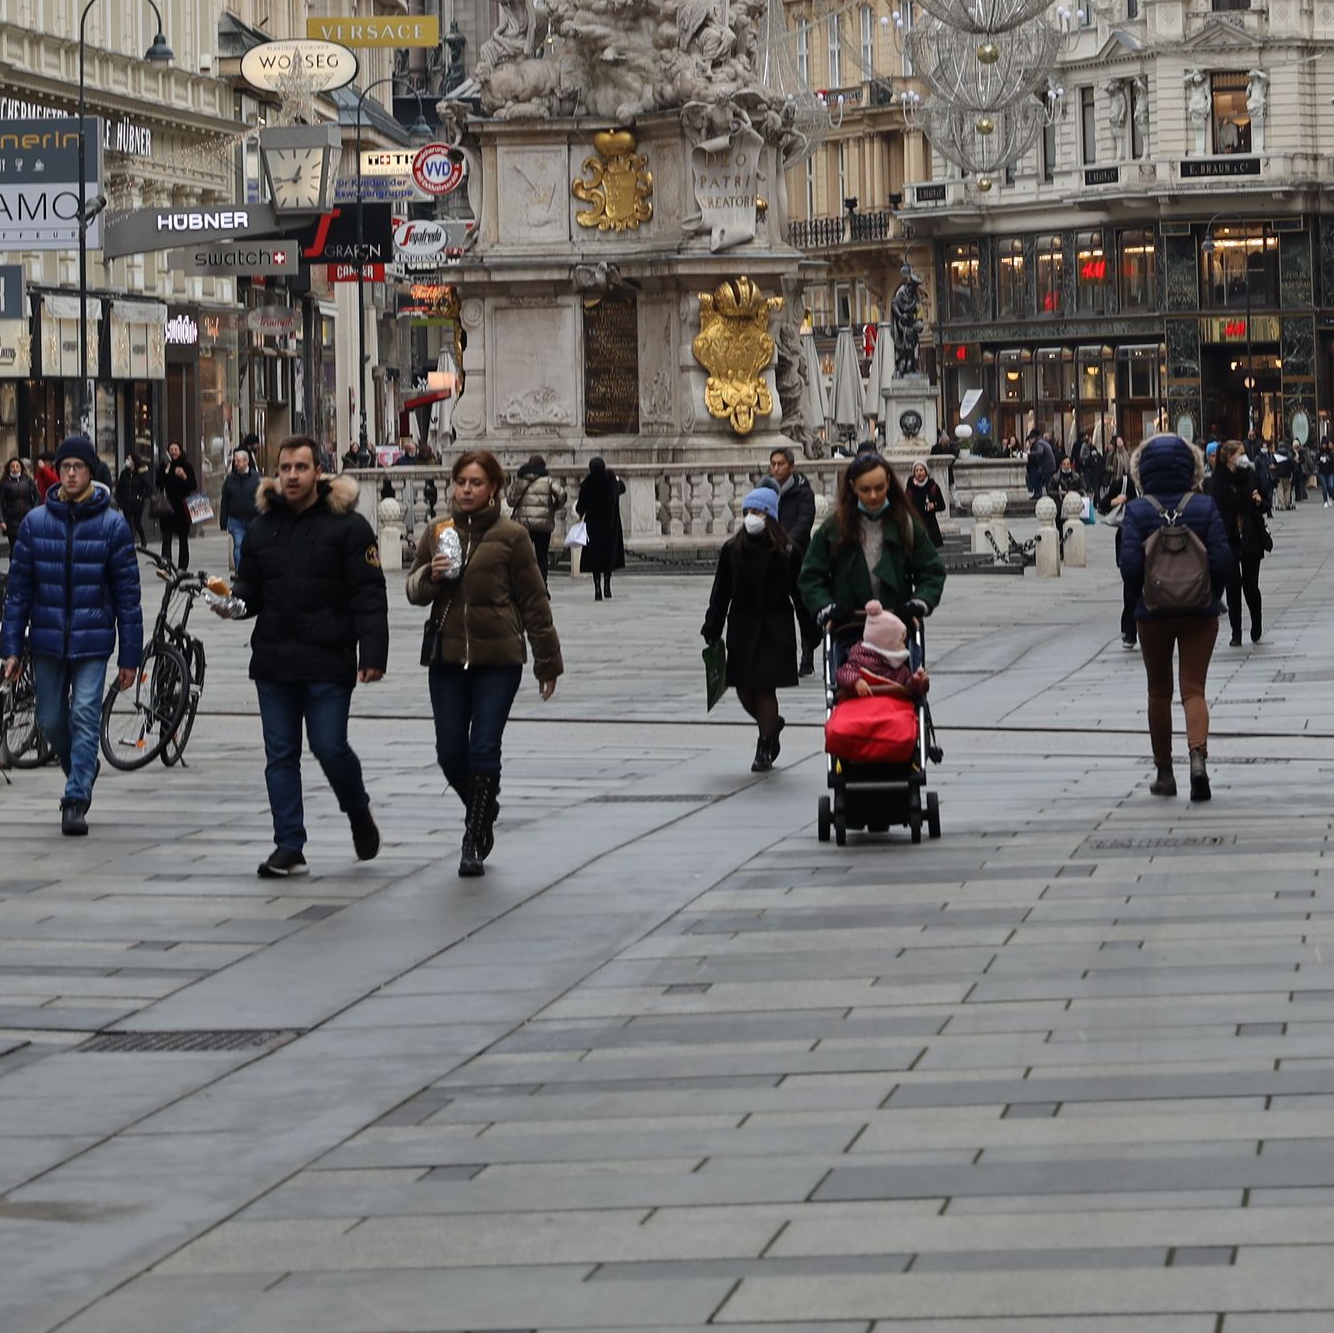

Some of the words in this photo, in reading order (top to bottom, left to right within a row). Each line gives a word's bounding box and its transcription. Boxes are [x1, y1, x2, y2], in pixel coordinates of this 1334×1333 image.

[321, 24, 425, 41] VERSACE
[259, 53, 339, 70] WOSEG
[117, 116, 152, 157] HÜBNER
[425, 160, 451, 177] VVD
[1200, 163, 1231, 174] BRAUN
[351, 177, 388, 187] Kunden
[390, 178, 407, 187] der
[700, 175, 751, 189] PATRI
[699, 195, 755, 209] CREATORI
[157, 212, 249, 231] HÜBNER
[194, 248, 271, 267] swatch
[324, 244, 381, 258] GRAN
[336, 264, 374, 280] CAMER
